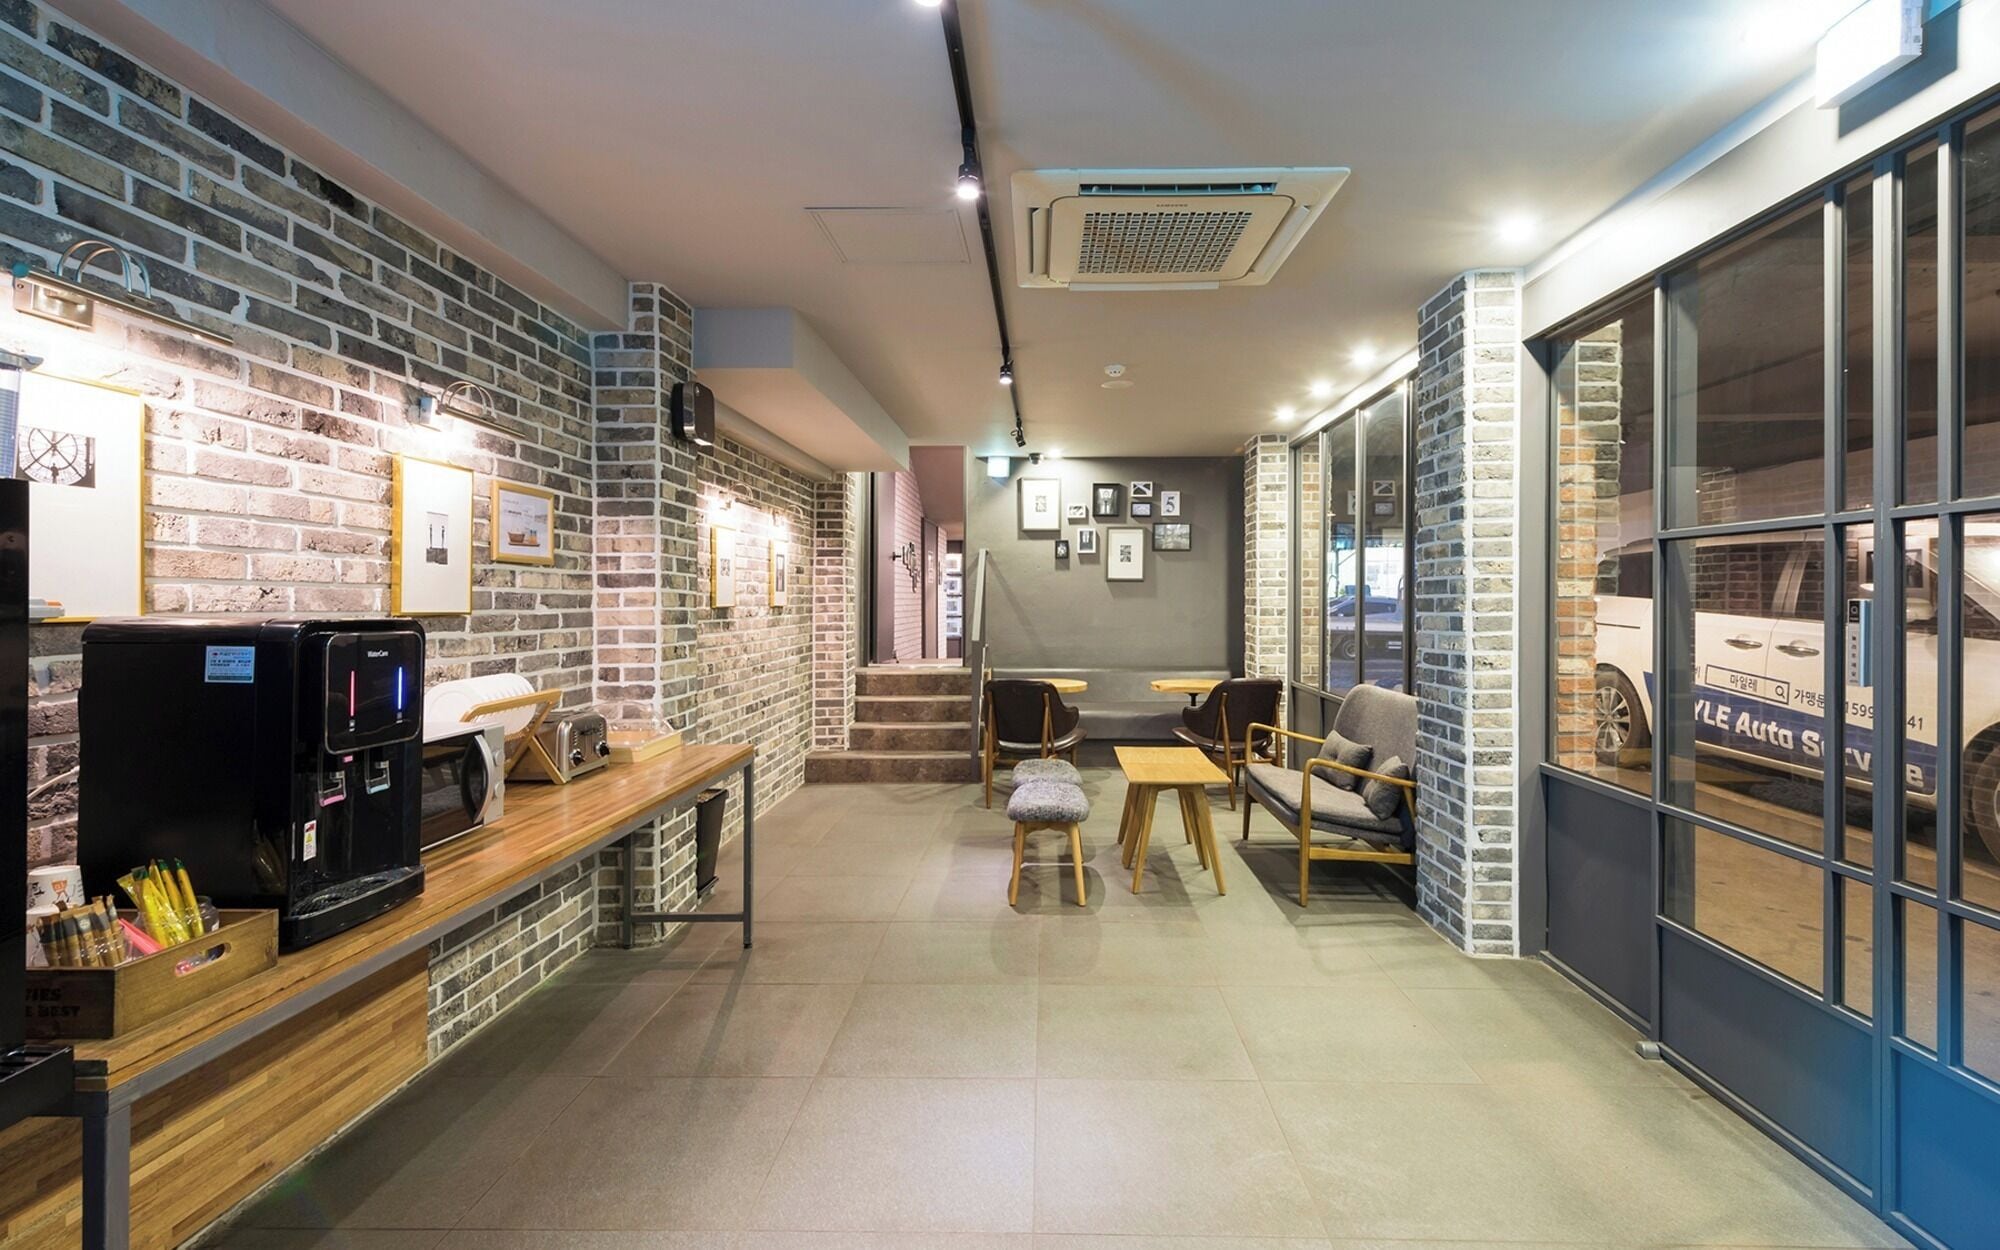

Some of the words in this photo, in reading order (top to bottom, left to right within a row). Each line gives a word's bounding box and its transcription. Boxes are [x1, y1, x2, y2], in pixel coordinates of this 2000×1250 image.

[1166, 496, 1175, 513] 5
[1729, 674, 1759, 692] 마일레
[1794, 689, 1825, 708] 가맹문
[1694, 699, 1732, 731] YLE
[1735, 711, 1794, 751] Auto
